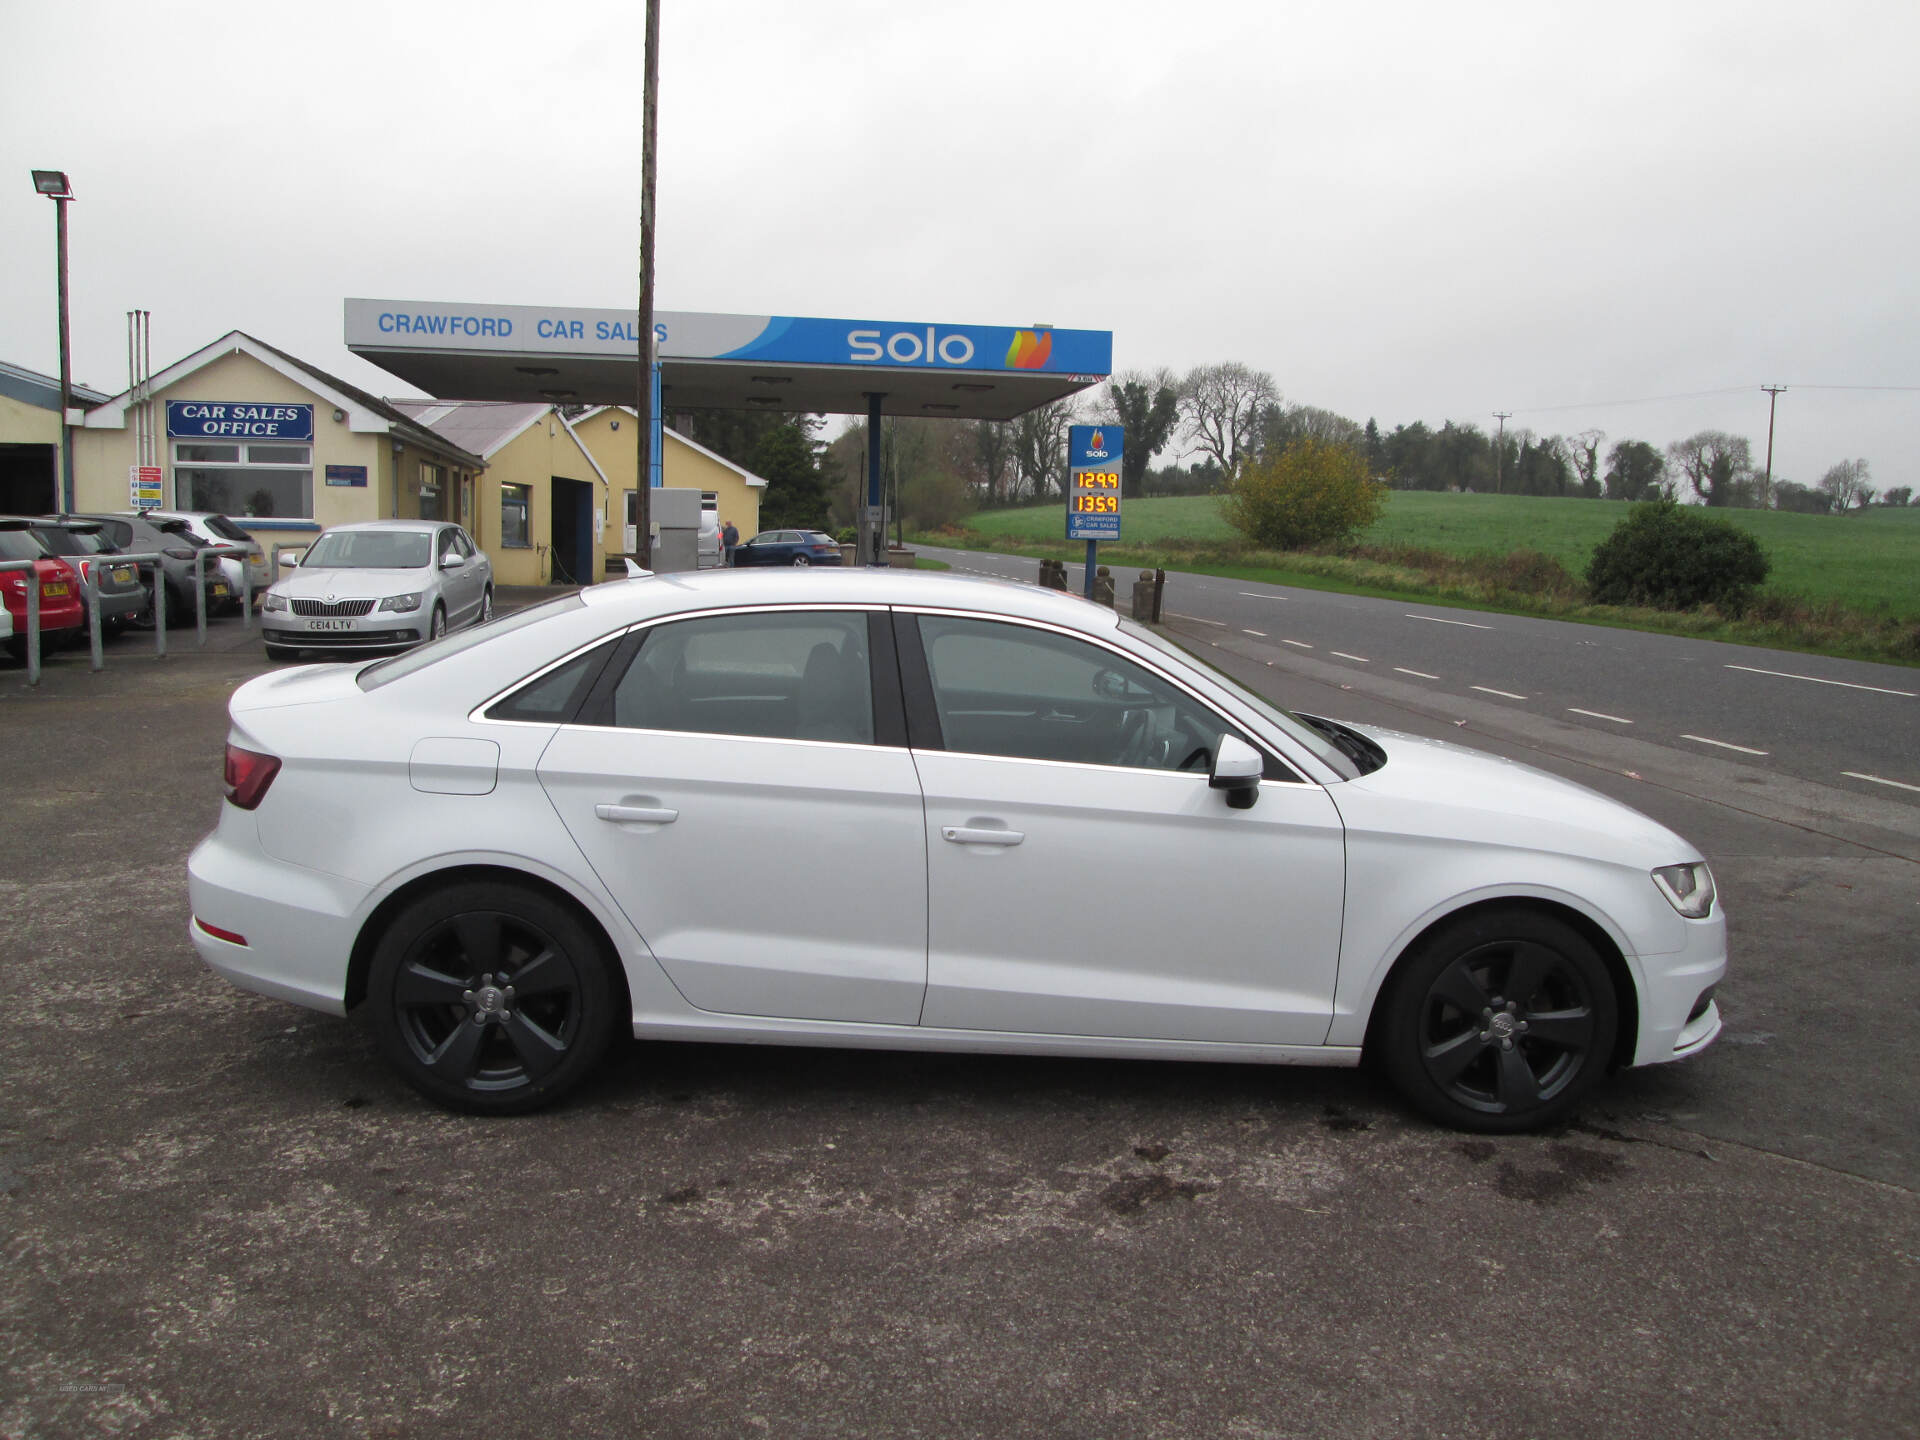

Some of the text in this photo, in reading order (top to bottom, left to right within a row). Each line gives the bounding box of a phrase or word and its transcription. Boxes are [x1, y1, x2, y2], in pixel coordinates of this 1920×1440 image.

[378, 313, 668, 342] CRAWFORD CAR SALS
[182, 405, 299, 421] CAR SALES
[203, 421, 279, 436] OFFICE
[1085, 449, 1109, 458] solo
[310, 620, 352, 630] CE14 LTV
